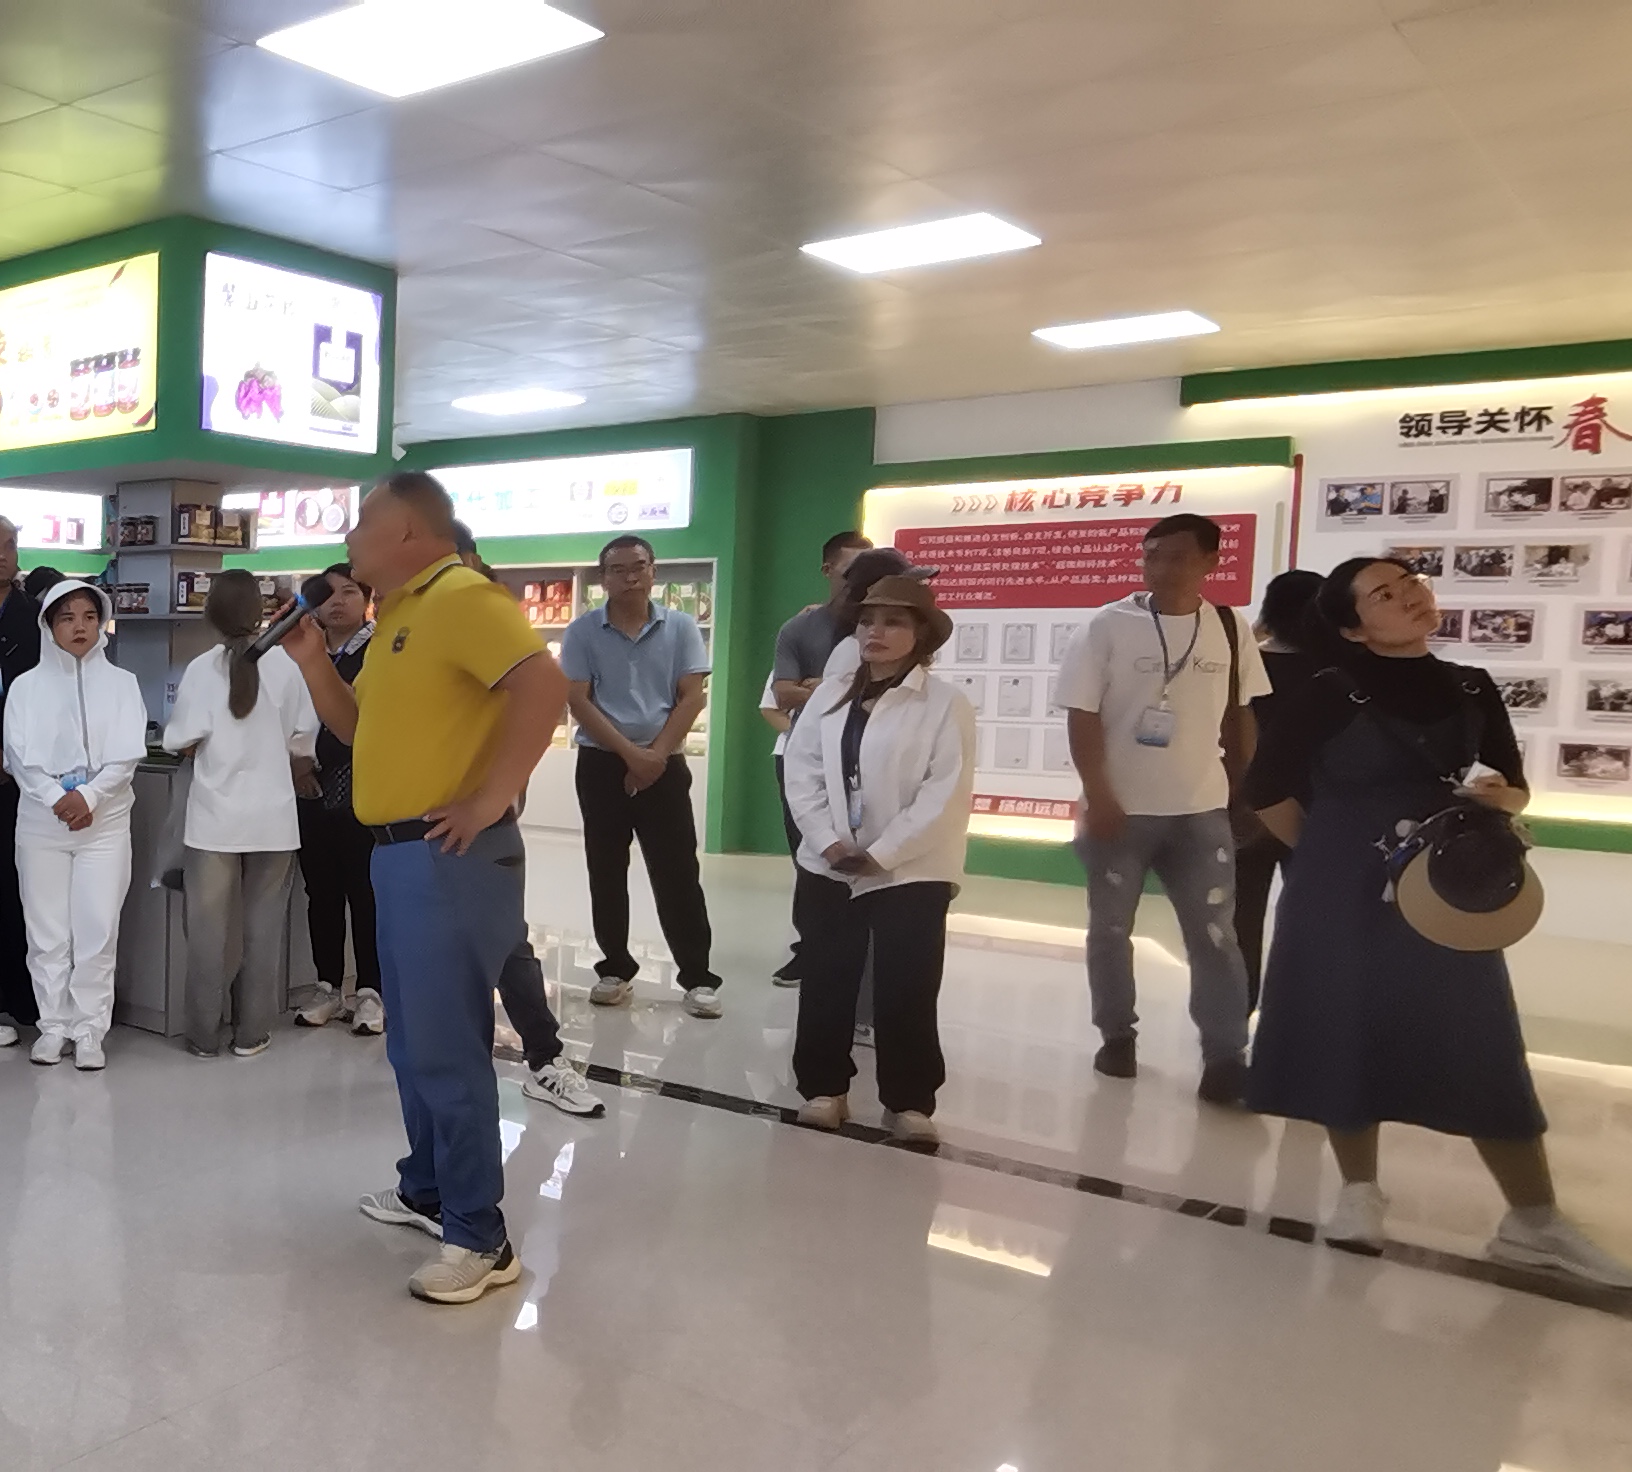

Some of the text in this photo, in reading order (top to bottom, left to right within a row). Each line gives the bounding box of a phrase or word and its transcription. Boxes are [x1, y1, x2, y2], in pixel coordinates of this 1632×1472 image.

[1398, 393, 1632, 455] 领导关怀 春
[1003, 481, 1184, 513] 核心竞争力
